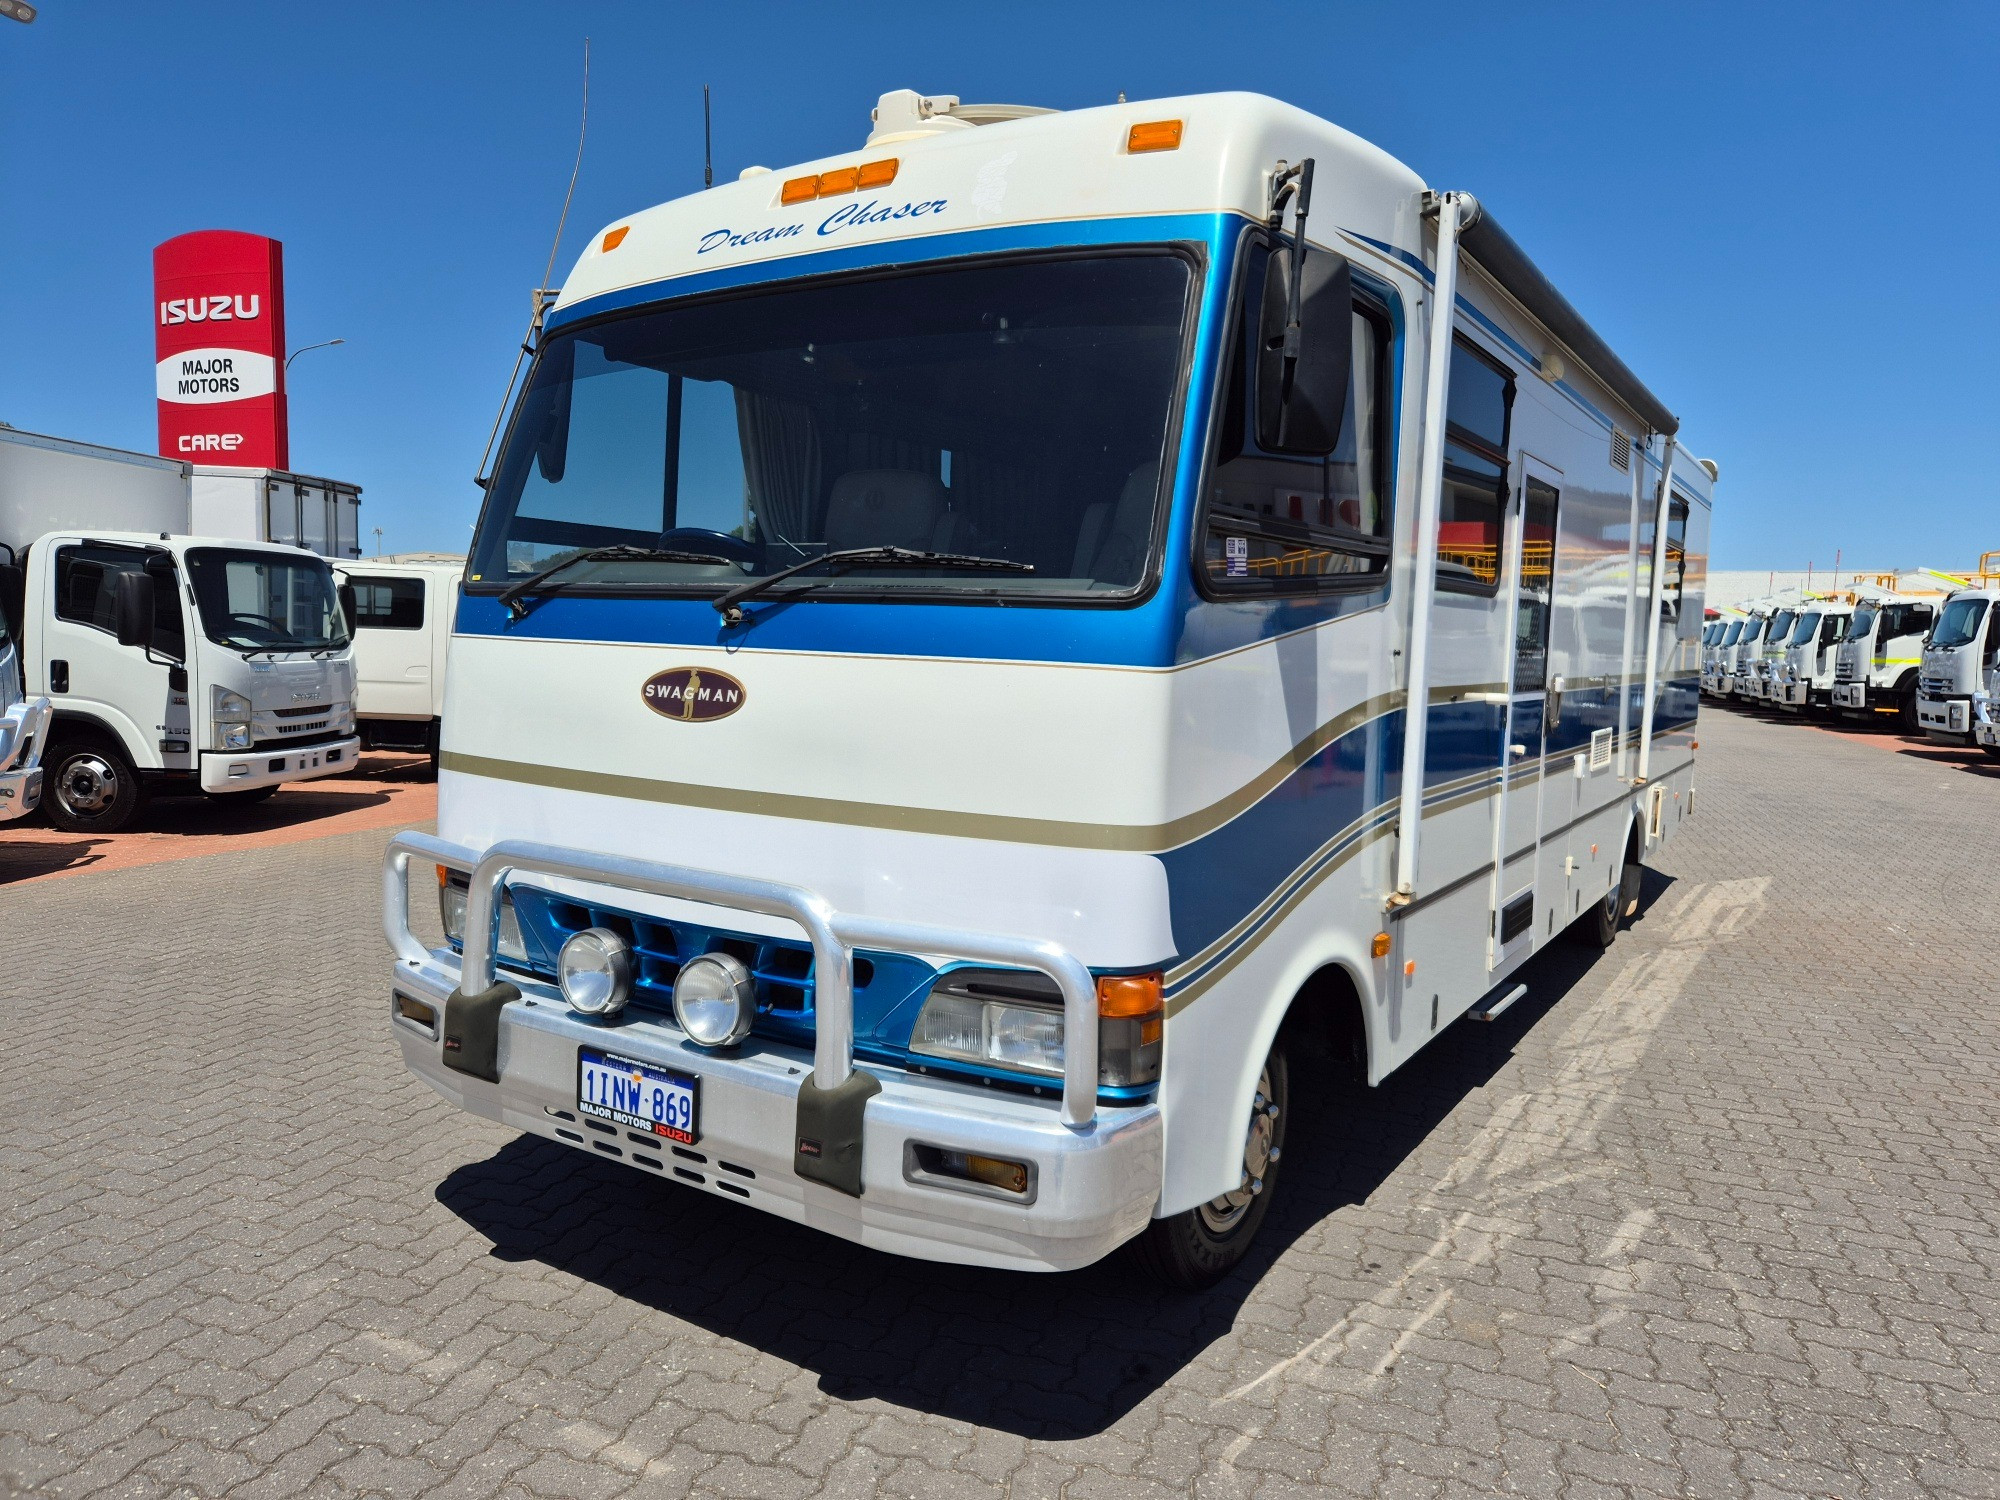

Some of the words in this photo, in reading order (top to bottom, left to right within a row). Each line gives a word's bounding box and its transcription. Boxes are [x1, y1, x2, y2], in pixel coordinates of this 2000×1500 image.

[697, 224, 804, 255] Dream
[816, 199, 948, 237] Chaser
[160, 294, 260, 325] ISUZU
[182, 358, 233, 376] MAJOR
[178, 377, 240, 395] MOTORS
[178, 433, 243, 452] CARE
[645, 684, 739, 703] SWAGMAN
[606, 1052, 667, 1073] www.majormotors.com.au
[580, 1101, 612, 1119] MAJOR
[613, 1112, 652, 1132] MOTORS
[655, 1123, 692, 1144] ISUZU
